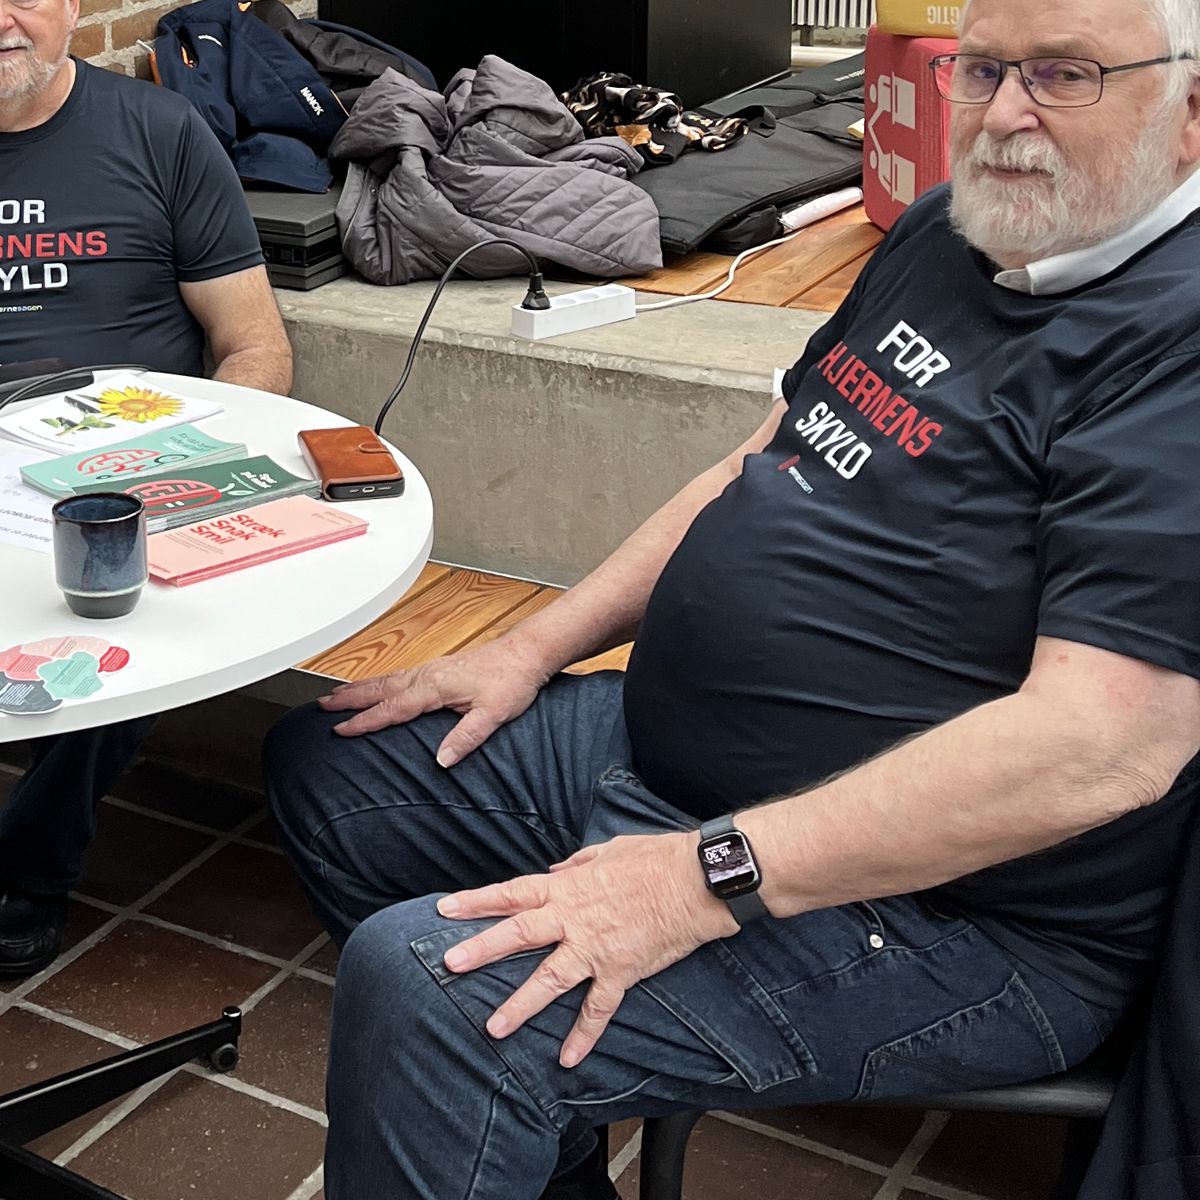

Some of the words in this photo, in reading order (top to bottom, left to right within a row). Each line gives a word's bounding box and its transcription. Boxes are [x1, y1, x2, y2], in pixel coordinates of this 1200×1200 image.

[876, 320, 951, 388] FOR
[816, 340, 944, 458] HJERNENS
[795, 401, 873, 480] SKYLD
[190, 525, 236, 545] Smil
[210, 520, 259, 541] Snak
[230, 514, 286, 539] Stræk
